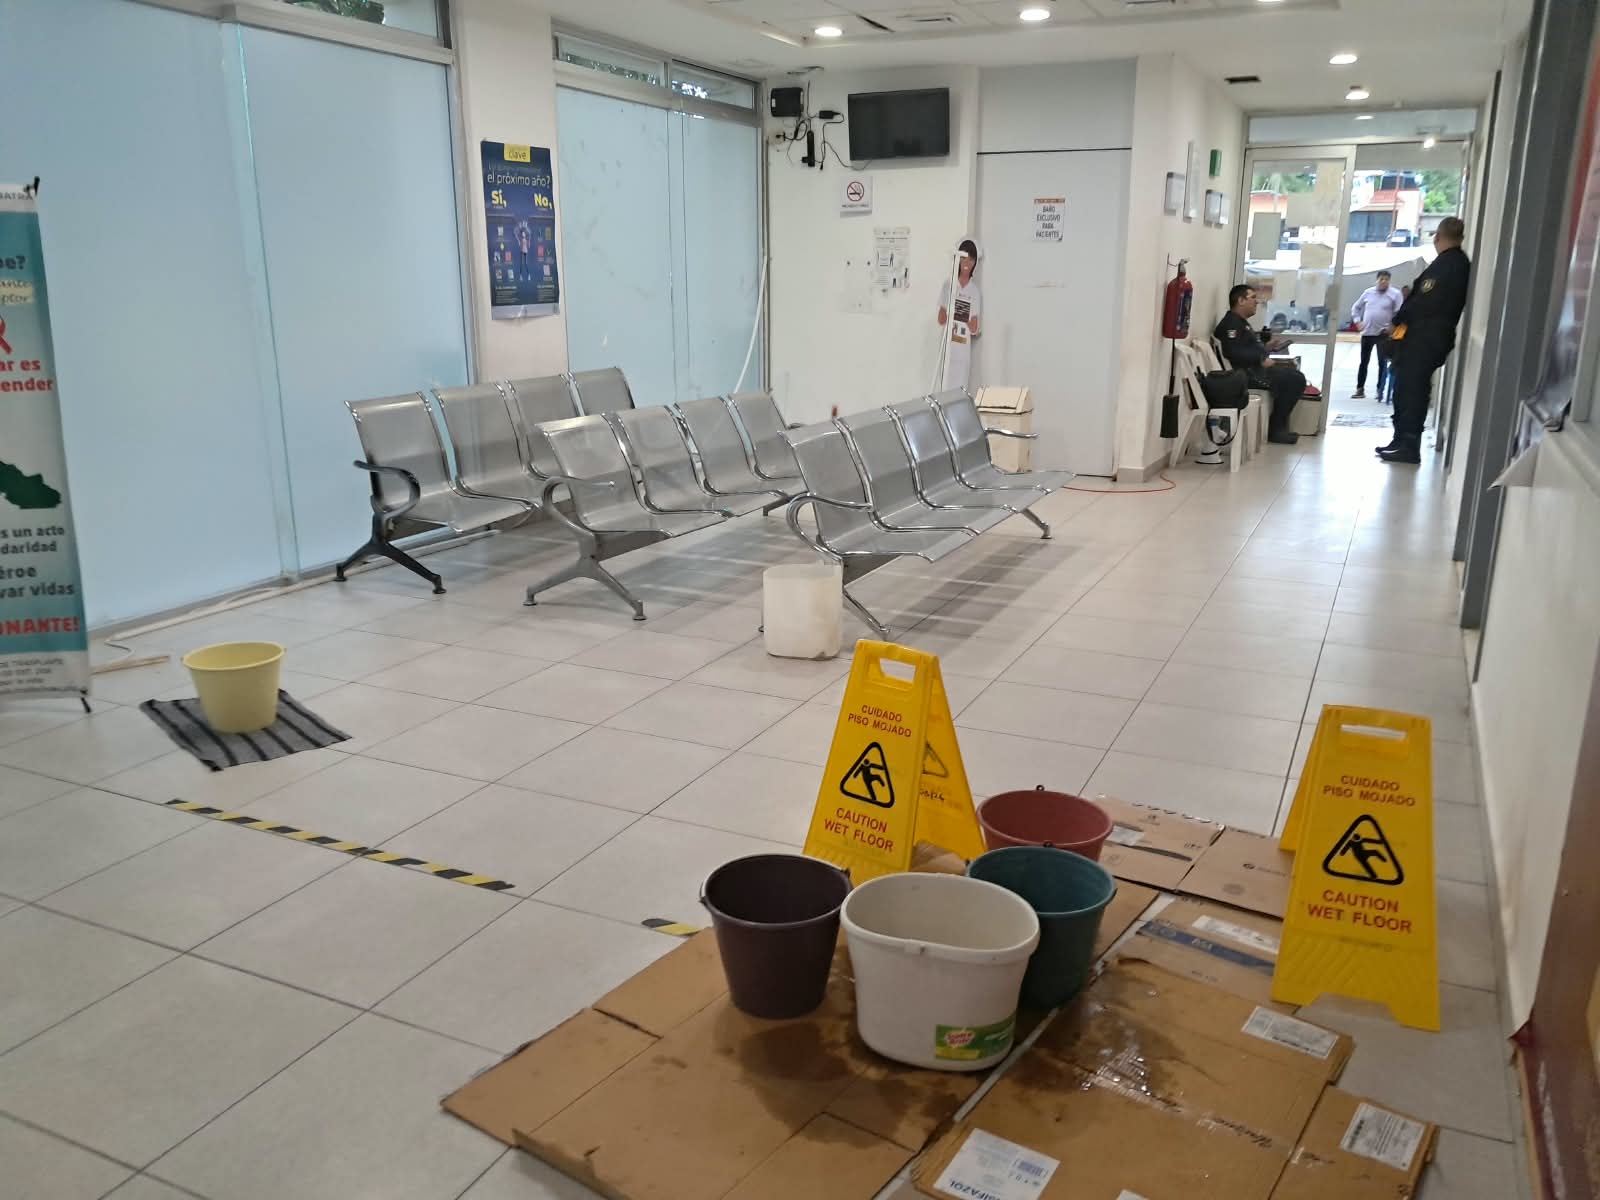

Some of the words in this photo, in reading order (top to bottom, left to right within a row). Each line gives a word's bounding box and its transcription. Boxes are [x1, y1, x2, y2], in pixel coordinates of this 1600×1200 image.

[487, 171, 495, 183] el
[497, 172, 530, 186] próximo
[531, 175, 551, 189] año?
[491, 189, 507, 208] Sí,
[20, 360, 41, 371] es
[1, 378, 53, 392] ender
[12, 528, 32, 537] un
[36, 525, 65, 536] acto
[1, 540, 58, 554] daridad
[30, 581, 75, 596] vidas
[861, 705, 902, 722] CUIDADO
[848, 713, 869, 726] PISO
[873, 720, 912, 738] MOJADO
[1341, 776, 1400, 791] CUIDADO
[1323, 785, 1353, 798] PISO
[1360, 791, 1416, 806] MOJADO
[835, 808, 887, 833] CAUTION
[824, 819, 849, 837] WET
[853, 829, 894, 852] FLOOR
[1323, 889, 1399, 913] CAUTION
[1308, 903, 1345, 921] WET
[1353, 912, 1413, 933] FLOOR
